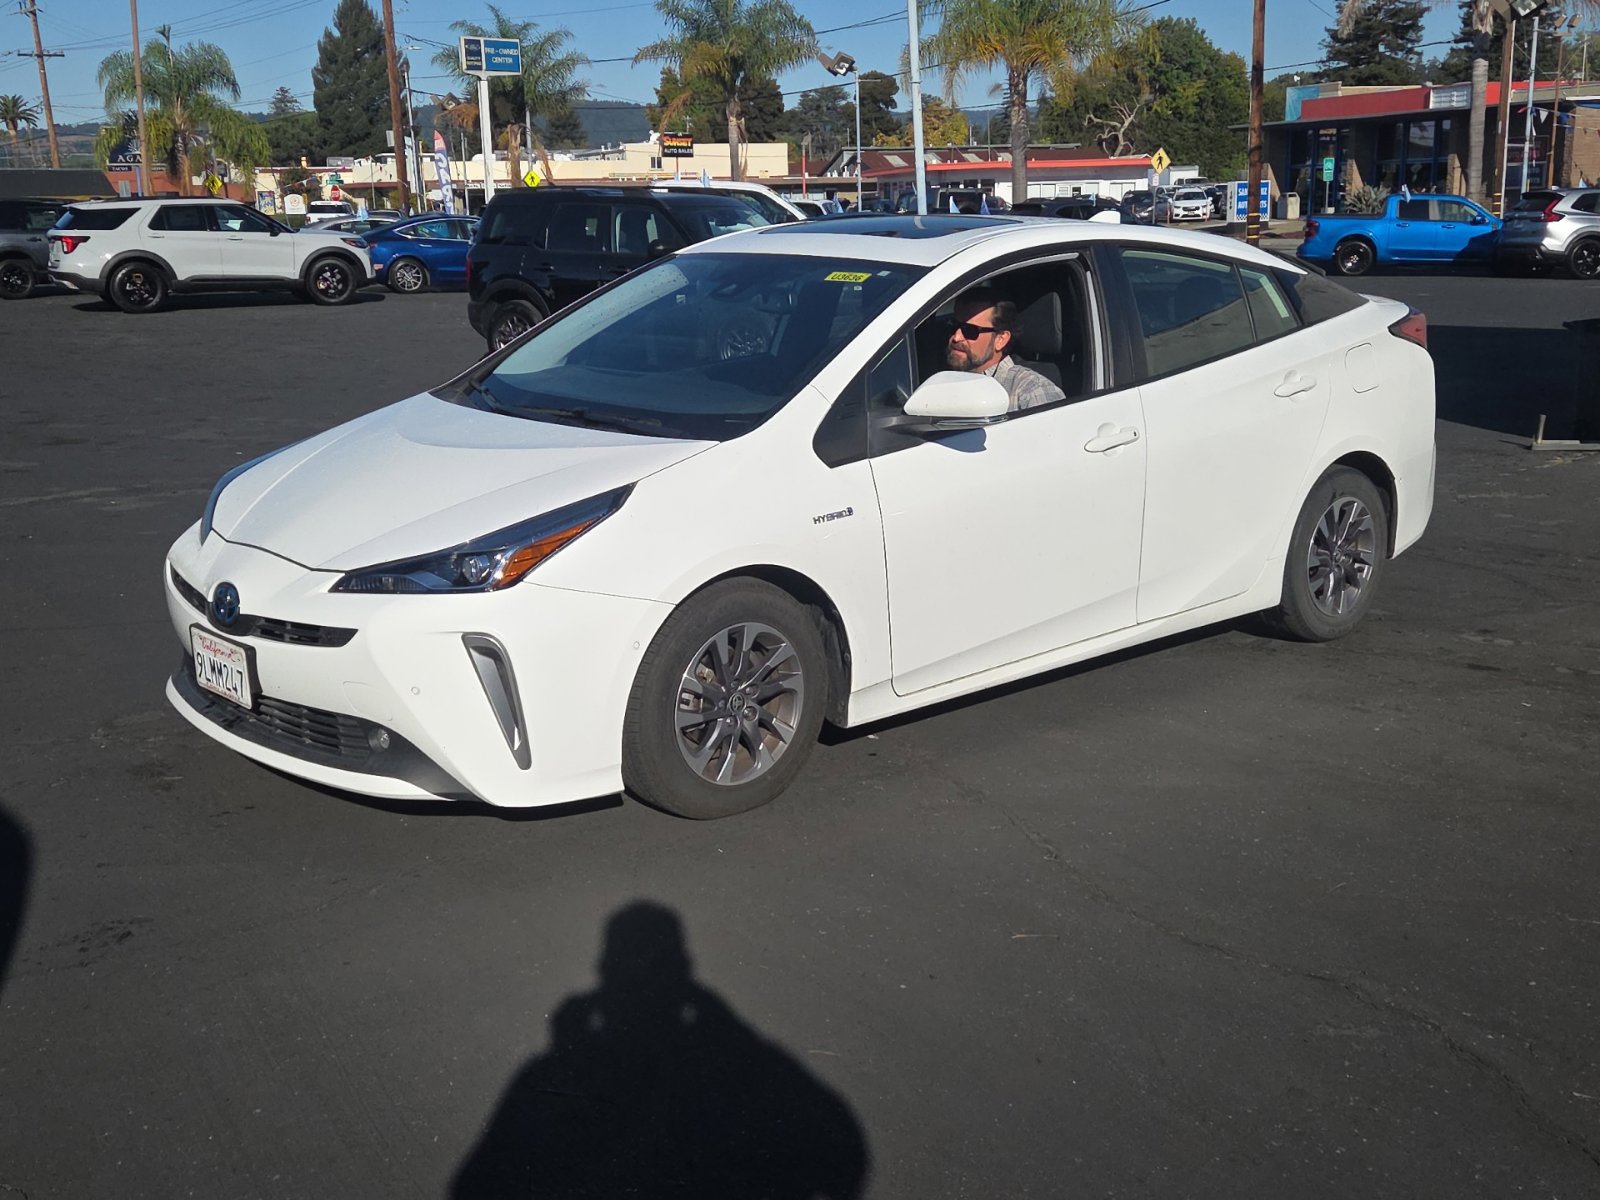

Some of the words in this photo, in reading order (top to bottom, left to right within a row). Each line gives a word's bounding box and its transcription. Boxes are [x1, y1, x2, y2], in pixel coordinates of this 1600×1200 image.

[663, 136, 692, 147] SUNSET
[117, 154, 159, 163] AGAE
[197, 651, 244, 698] 9LMM247
